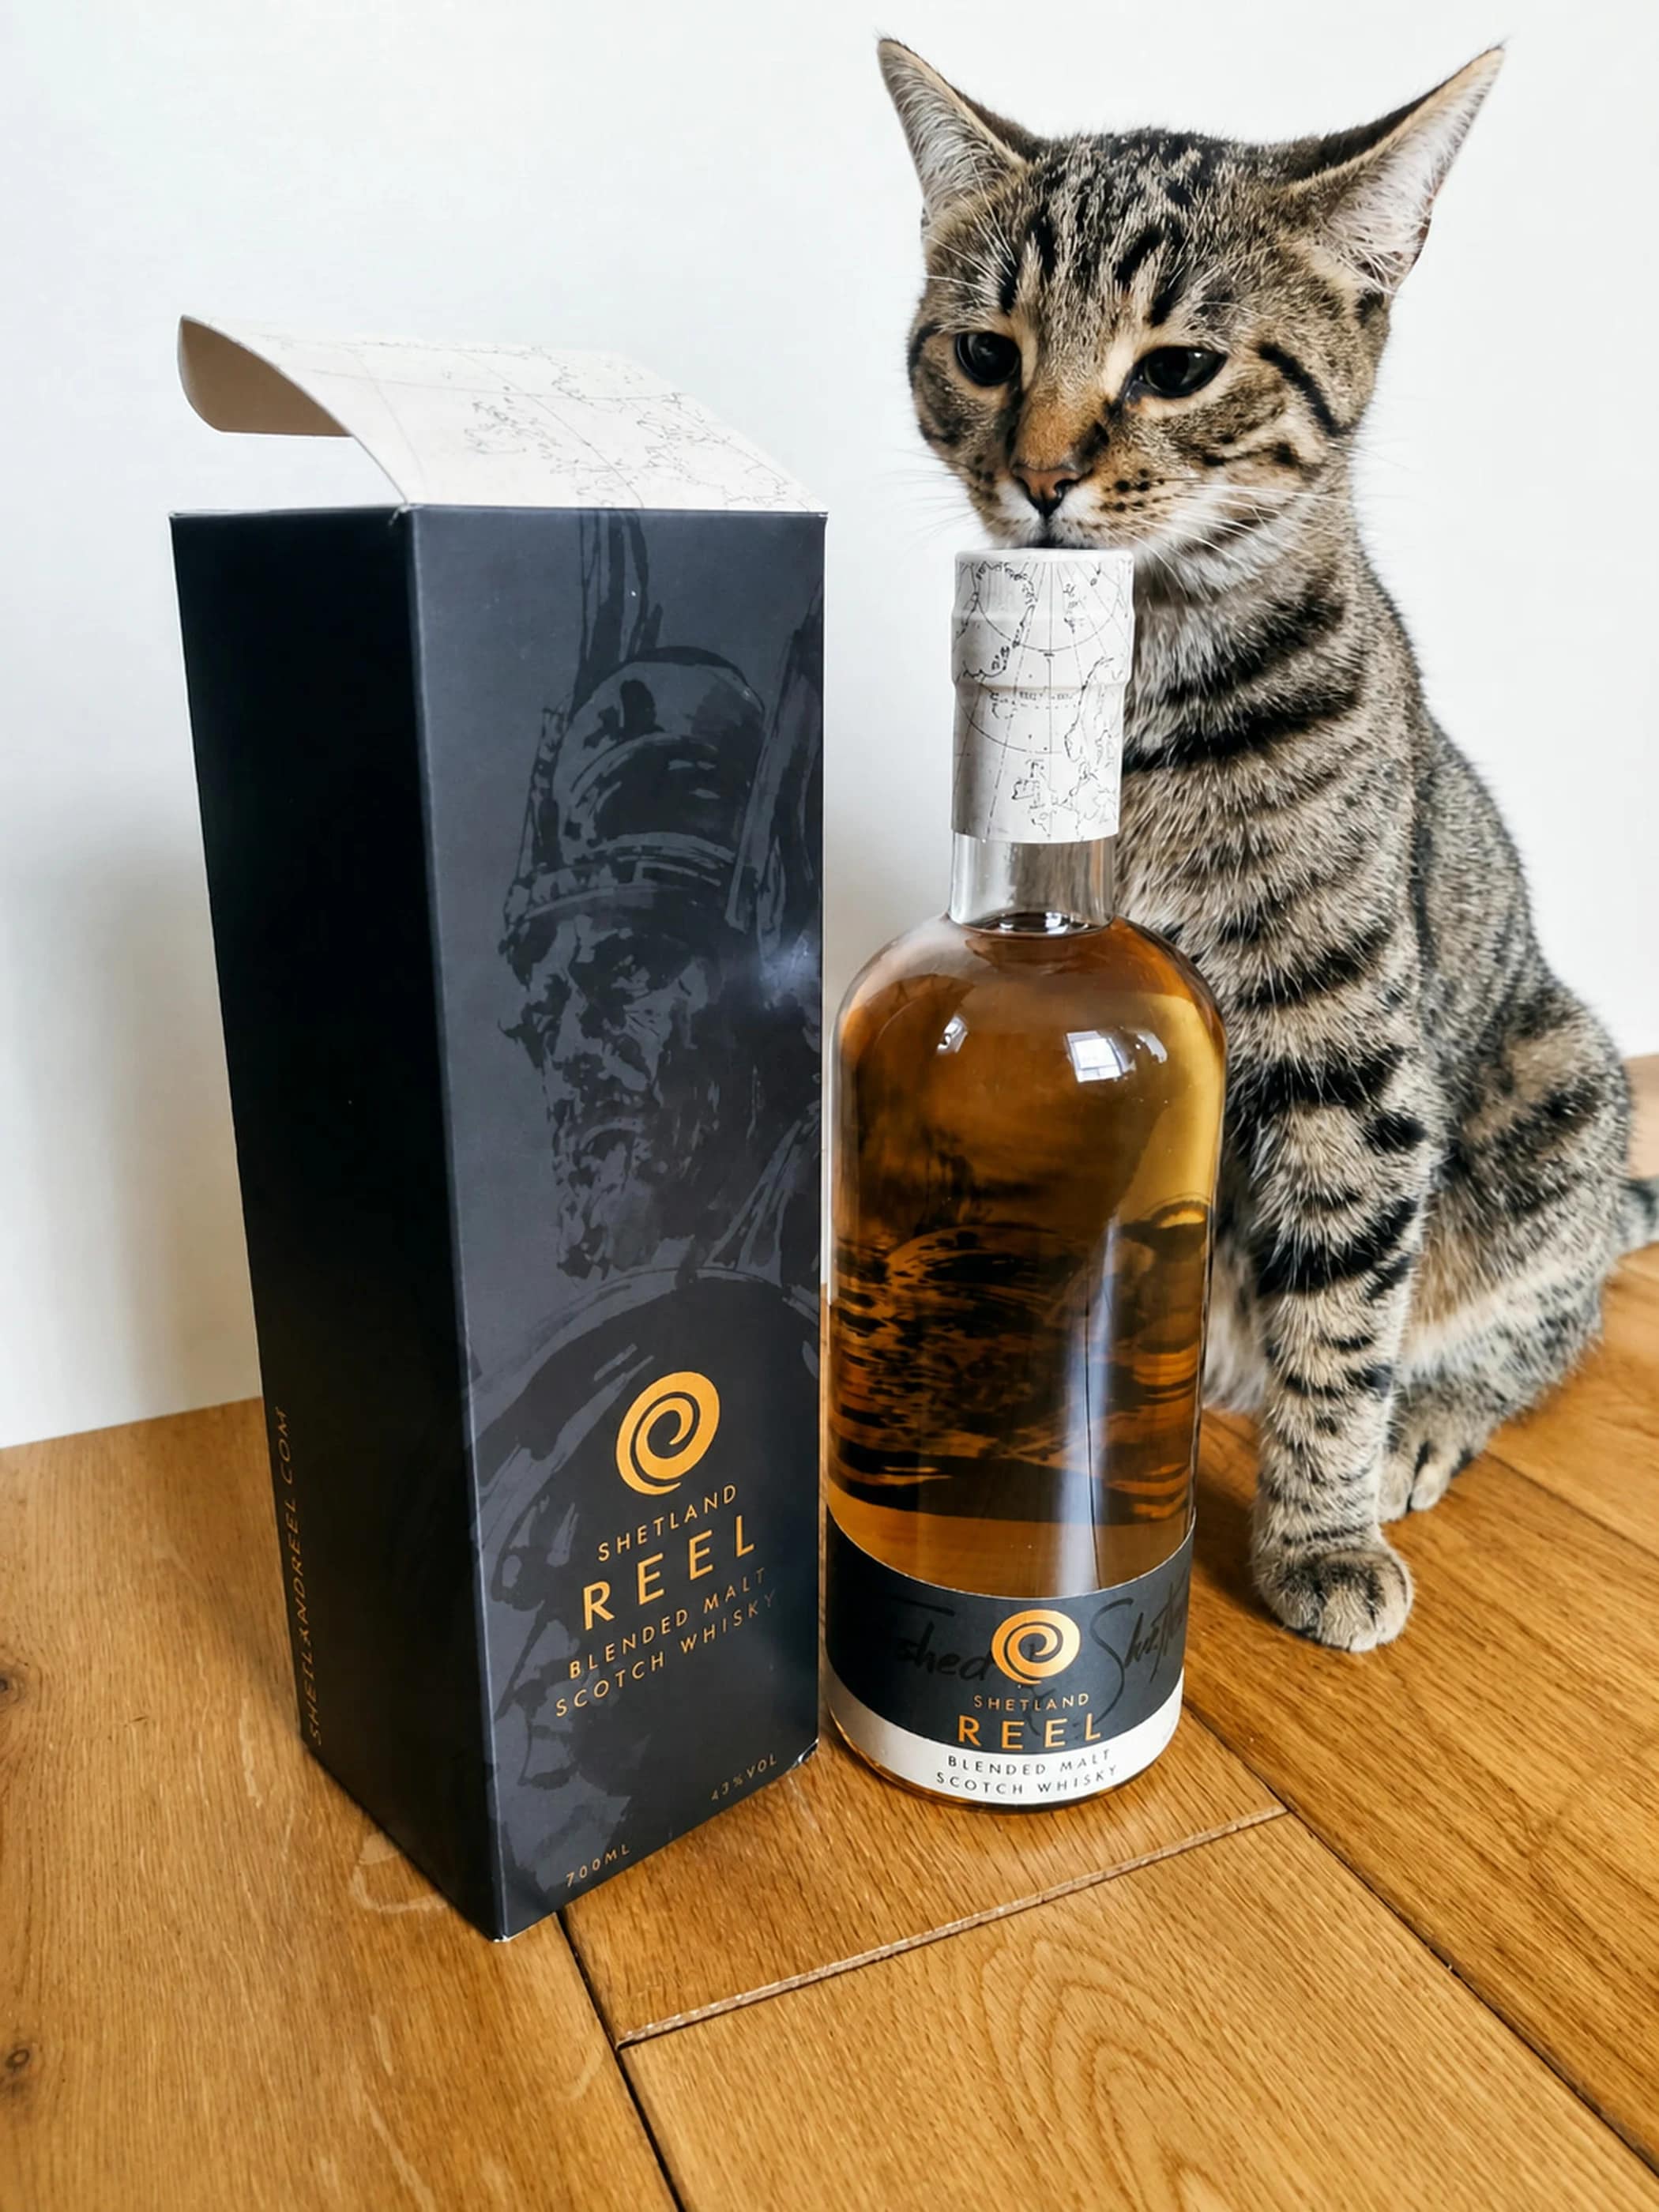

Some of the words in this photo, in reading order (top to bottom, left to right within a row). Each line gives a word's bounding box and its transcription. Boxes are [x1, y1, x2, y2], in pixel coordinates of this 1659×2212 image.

[597, 1484, 737, 1562] SHETLAND
[582, 1514, 755, 1631] REEL
[569, 1609, 689, 1680] BLENDED
[703, 1567, 765, 1614] MALT
[555, 1651, 664, 1717] SCOTCH
[680, 1588, 776, 1654] WHISKY
[973, 1692, 1089, 1712] SHETLAND
[957, 1713, 1101, 1750] REEL
[936, 1771, 1024, 1795] SCOTCH
[1036, 1764, 1117, 1794] WHISKY
[947, 1755, 1047, 1776] BLENDED
[1059, 1748, 1111, 1773] MALT
[565, 1843, 631, 1887] 700ML
